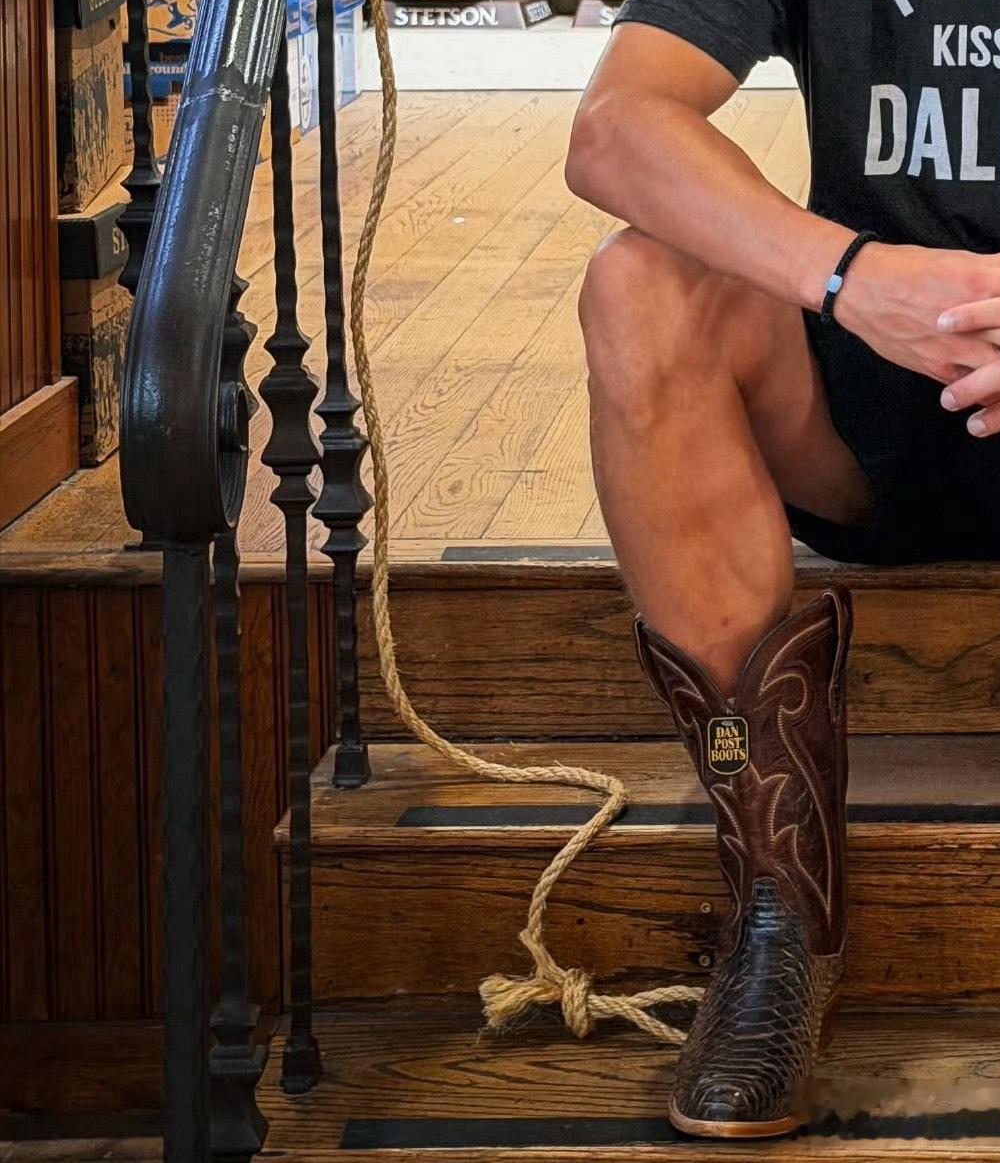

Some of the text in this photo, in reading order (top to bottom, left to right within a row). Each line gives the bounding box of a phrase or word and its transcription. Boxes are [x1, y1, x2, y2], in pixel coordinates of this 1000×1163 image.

[394, 6, 498, 26] STETSON
[716, 726, 739, 738] DAN
[714, 737, 745, 749] POST
[711, 749, 746, 762] BOOTS
